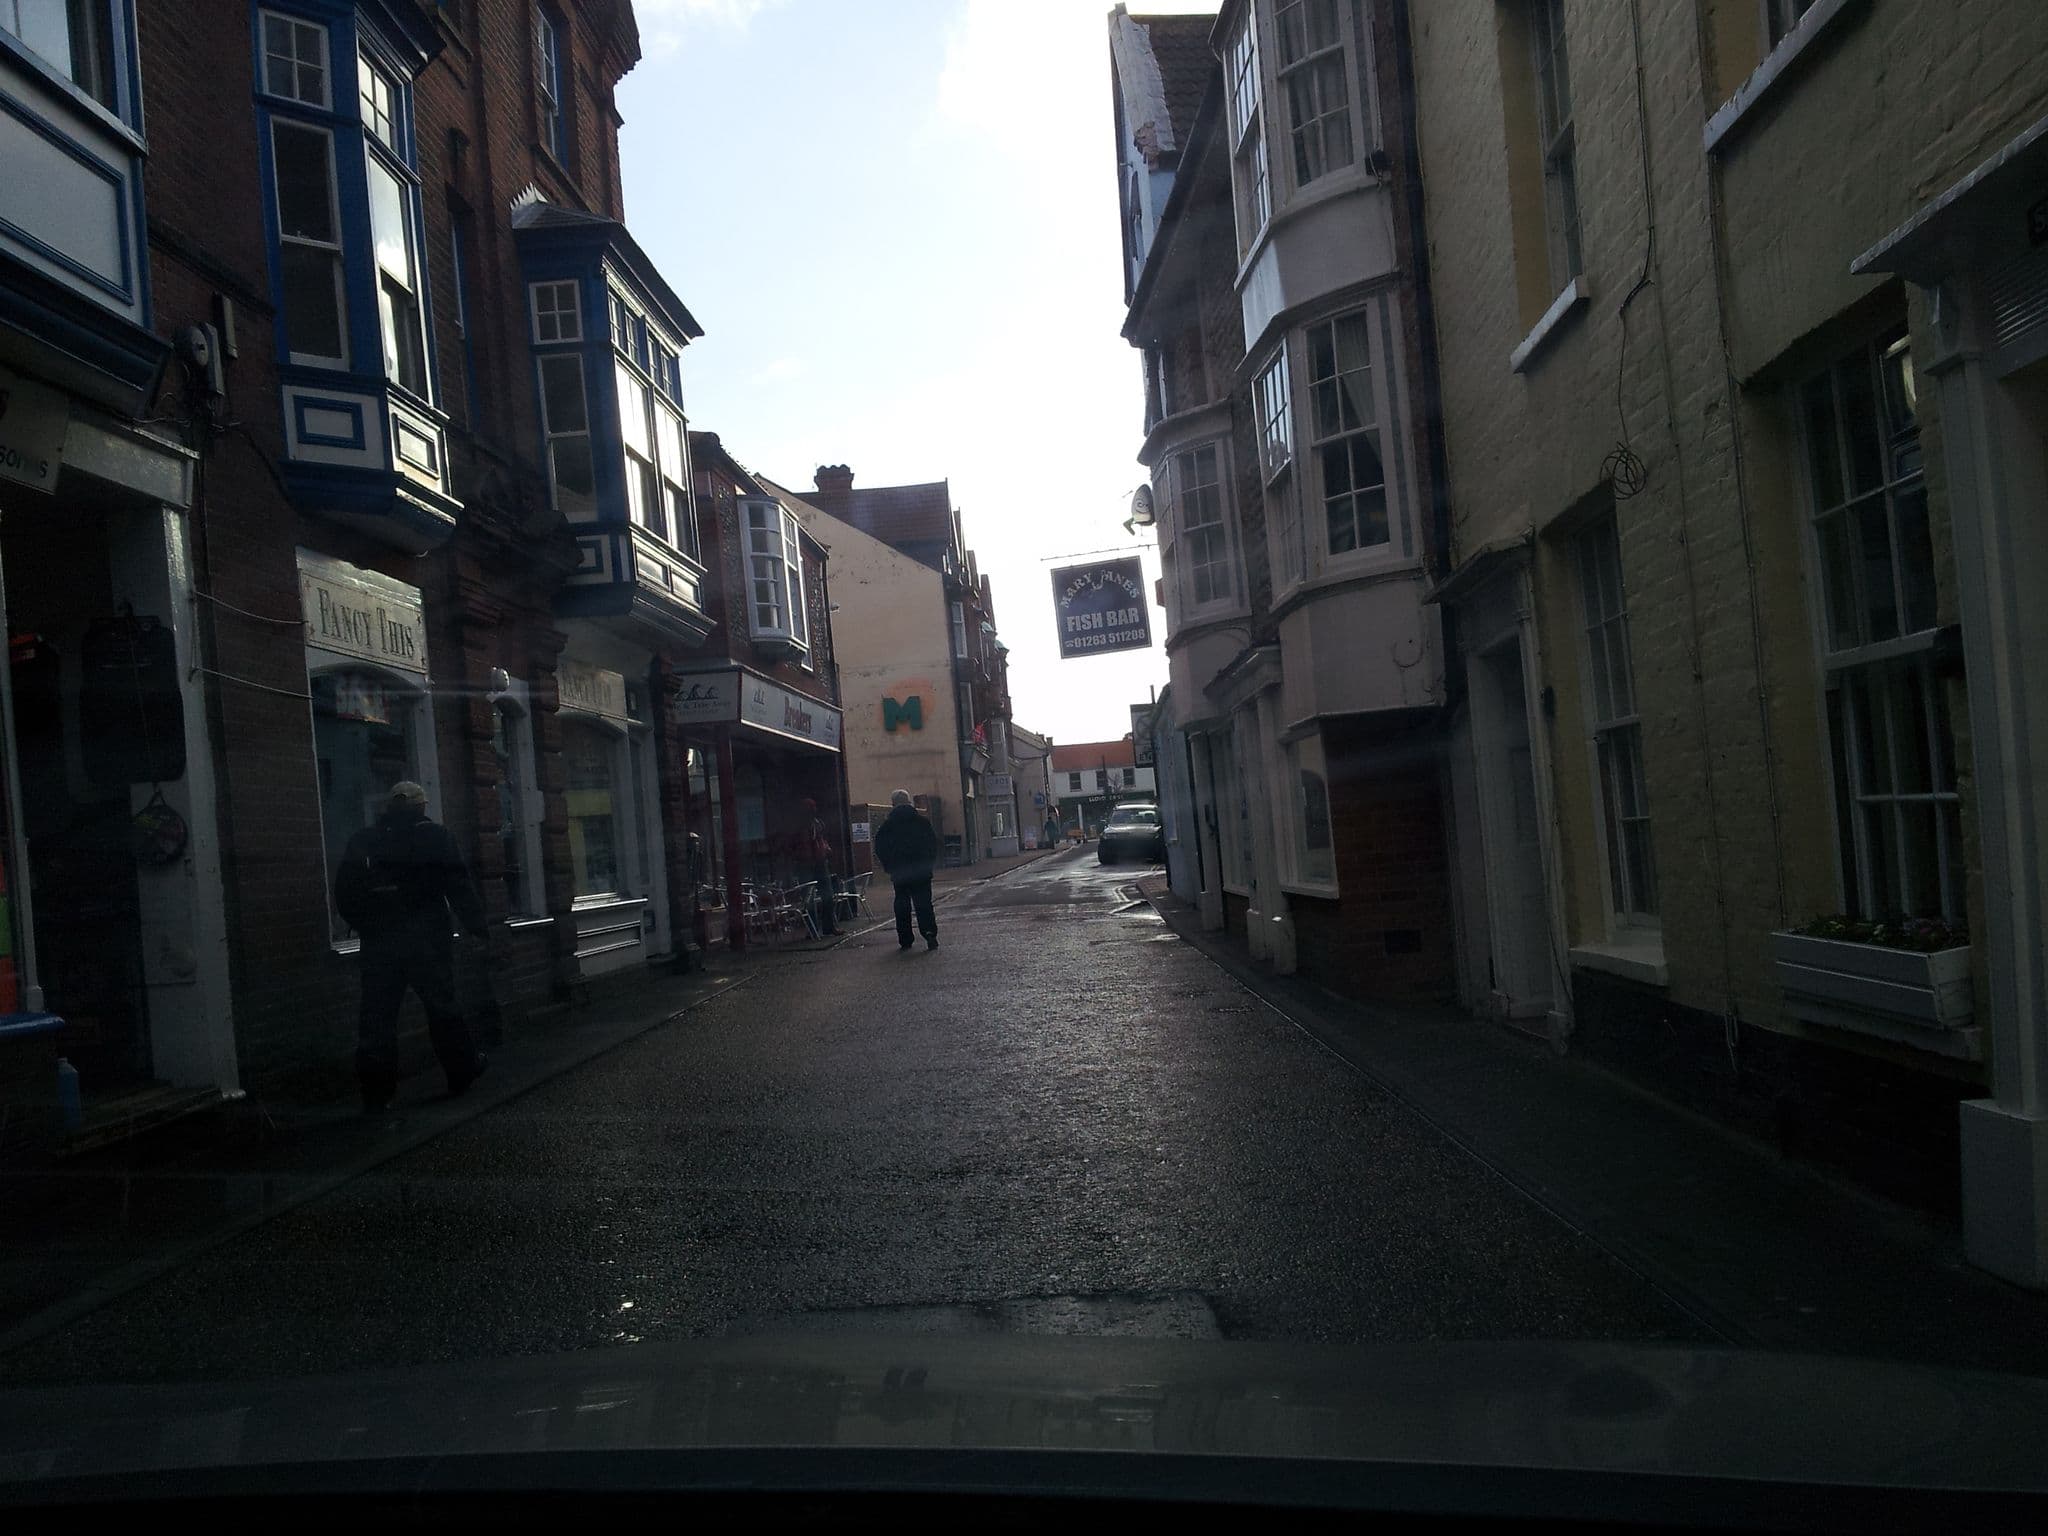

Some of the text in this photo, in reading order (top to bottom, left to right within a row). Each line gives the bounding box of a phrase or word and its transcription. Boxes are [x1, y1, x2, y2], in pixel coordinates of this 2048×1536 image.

[1060, 571, 1093, 608] MARY
[317, 587, 415, 658] FANCY THIS
[1066, 607, 1140, 632] FISH BAR
[1074, 635, 1107, 648] 01263
[883, 695, 923, 731] M
